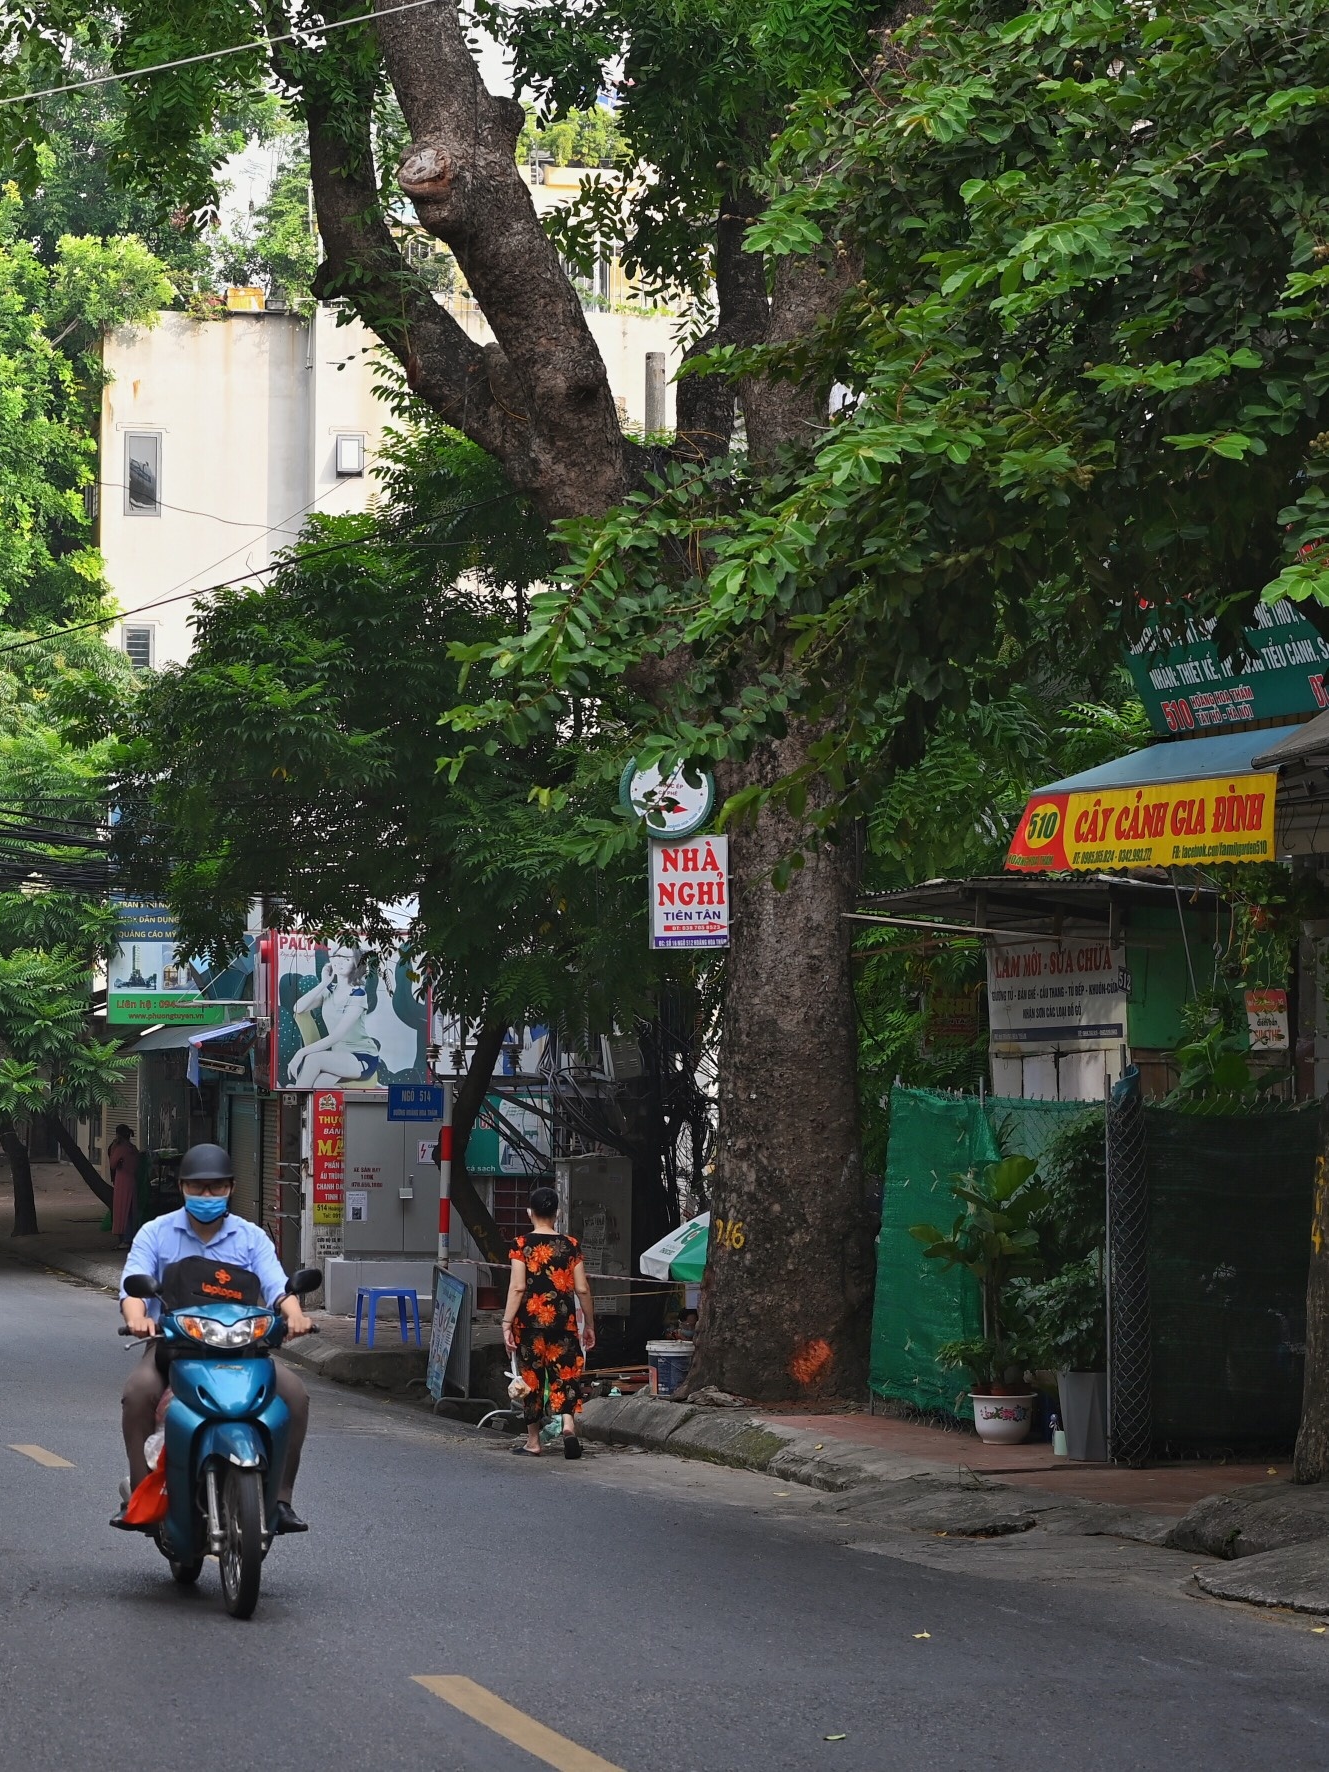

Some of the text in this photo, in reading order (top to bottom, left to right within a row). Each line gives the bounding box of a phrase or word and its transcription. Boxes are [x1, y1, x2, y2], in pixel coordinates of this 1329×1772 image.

[1149, 662, 1180, 692] NHẬN:
[1176, 654, 1205, 686] THIẾT
[1261, 637, 1287, 670] TIỂU
[1285, 635, 1321, 666] CẢNH,
[1189, 683, 1255, 709] HOÀNG HOA THÁM
[1161, 698, 1195, 732] 510
[1194, 708, 1212, 726] TÂY
[1228, 704, 1240, 721] HÀ
[1238, 702, 1255, 721] NỘI
[1027, 811, 1059, 841] 510
[1073, 784, 1266, 844] CÂY CẢNH GIA ĐÌNH
[661, 840, 720, 873] NHÀ
[657, 872, 726, 906] NGHỈ
[139, 915, 180, 924] DÂN DỤNG
[663, 909, 721, 921] TIÊN TÂN
[147, 930, 163, 938] CÁO
[995, 949, 1021, 978] LÀM
[1022, 946, 1042, 976] MỚI
[1077, 943, 1112, 972] CHỮA
[1049, 986, 1064, 998] THANG
[1118, 971, 1131, 991] 512
[402, 1088, 431, 1102] NGÕ 514
